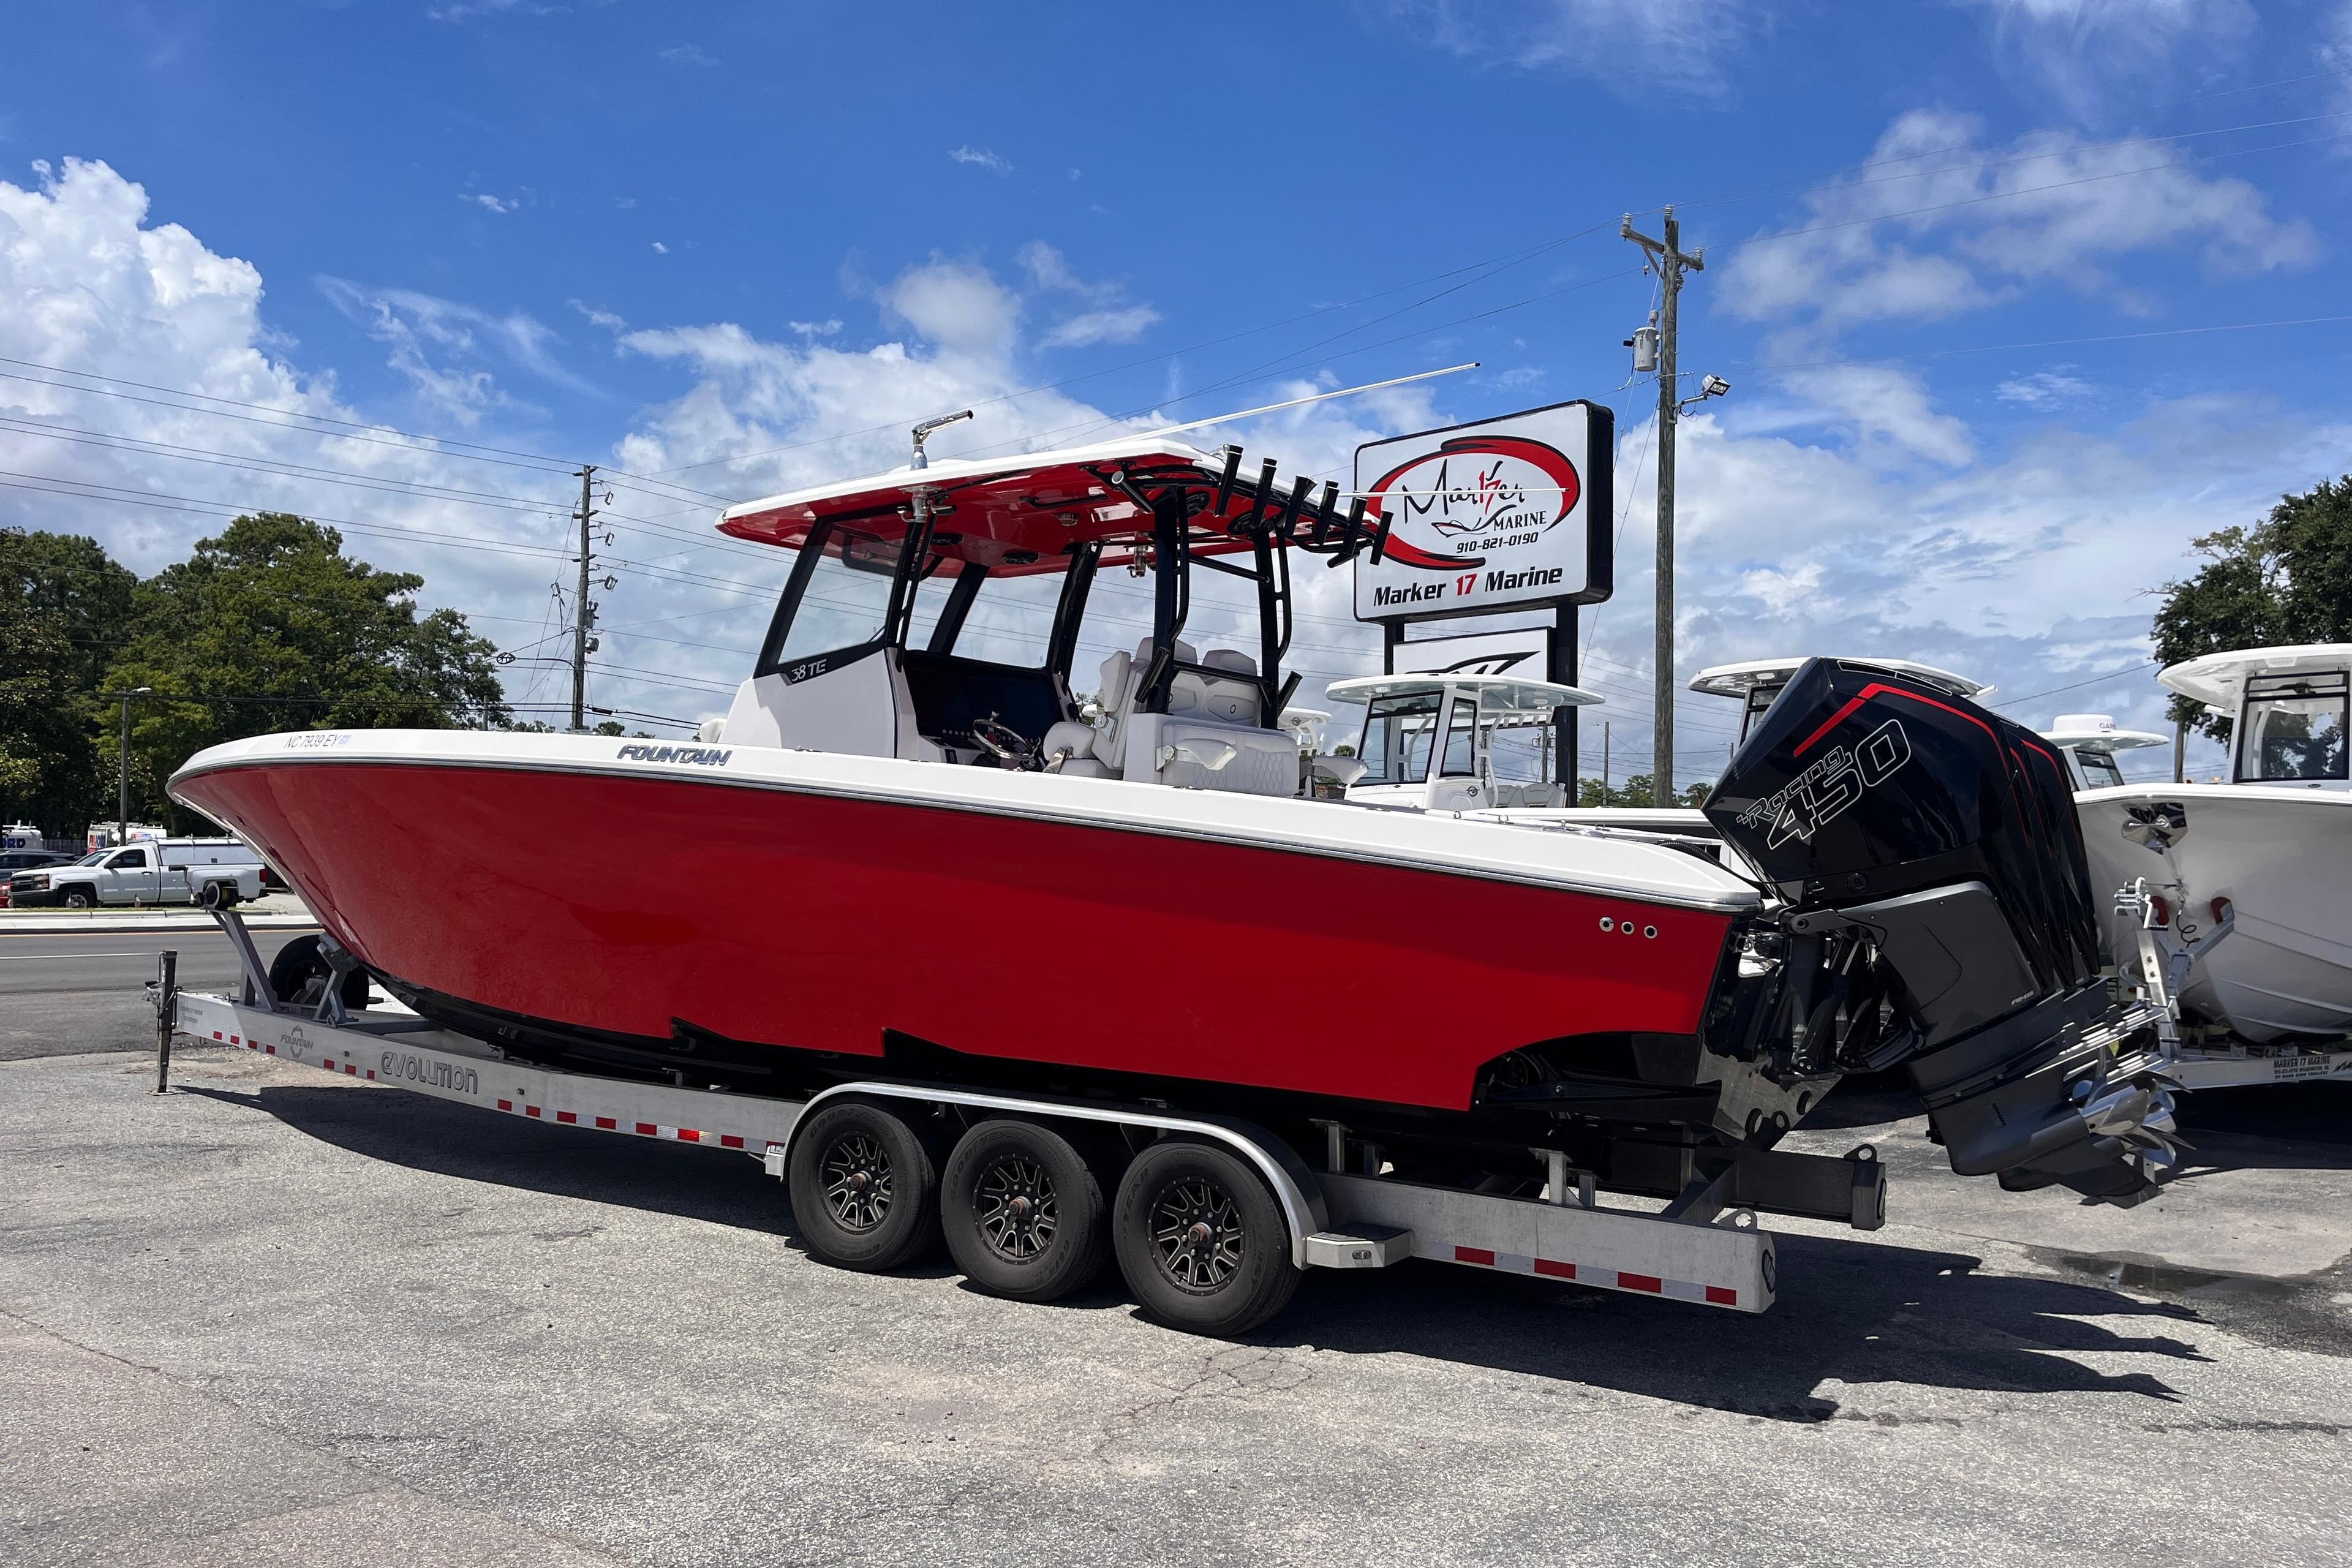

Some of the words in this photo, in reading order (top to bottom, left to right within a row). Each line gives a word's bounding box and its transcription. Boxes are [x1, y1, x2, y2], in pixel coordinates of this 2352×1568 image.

[1493, 510, 1547, 531] MARINE
[1457, 532, 1539, 554] 910-821-0190
[1373, 582, 1447, 607] Marker
[1456, 574, 1478, 596] 17
[1485, 567, 1562, 592] Marine
[791, 664, 807, 681] 38
[808, 658, 827, 676] TE
[284, 736, 302, 748] NC
[300, 735, 325, 747] 7939
[323, 734, 343, 747] EY
[617, 744, 733, 766] FOUNTAIN
[1741, 745, 1847, 829] Racing
[1766, 718, 1911, 851] 450
[280, 1034, 314, 1050] FOUNTAIN
[2274, 1058, 2298, 1068] MARKER
[2300, 1058, 2307, 1066] 17
[2308, 1055, 2331, 1065] MARINE
